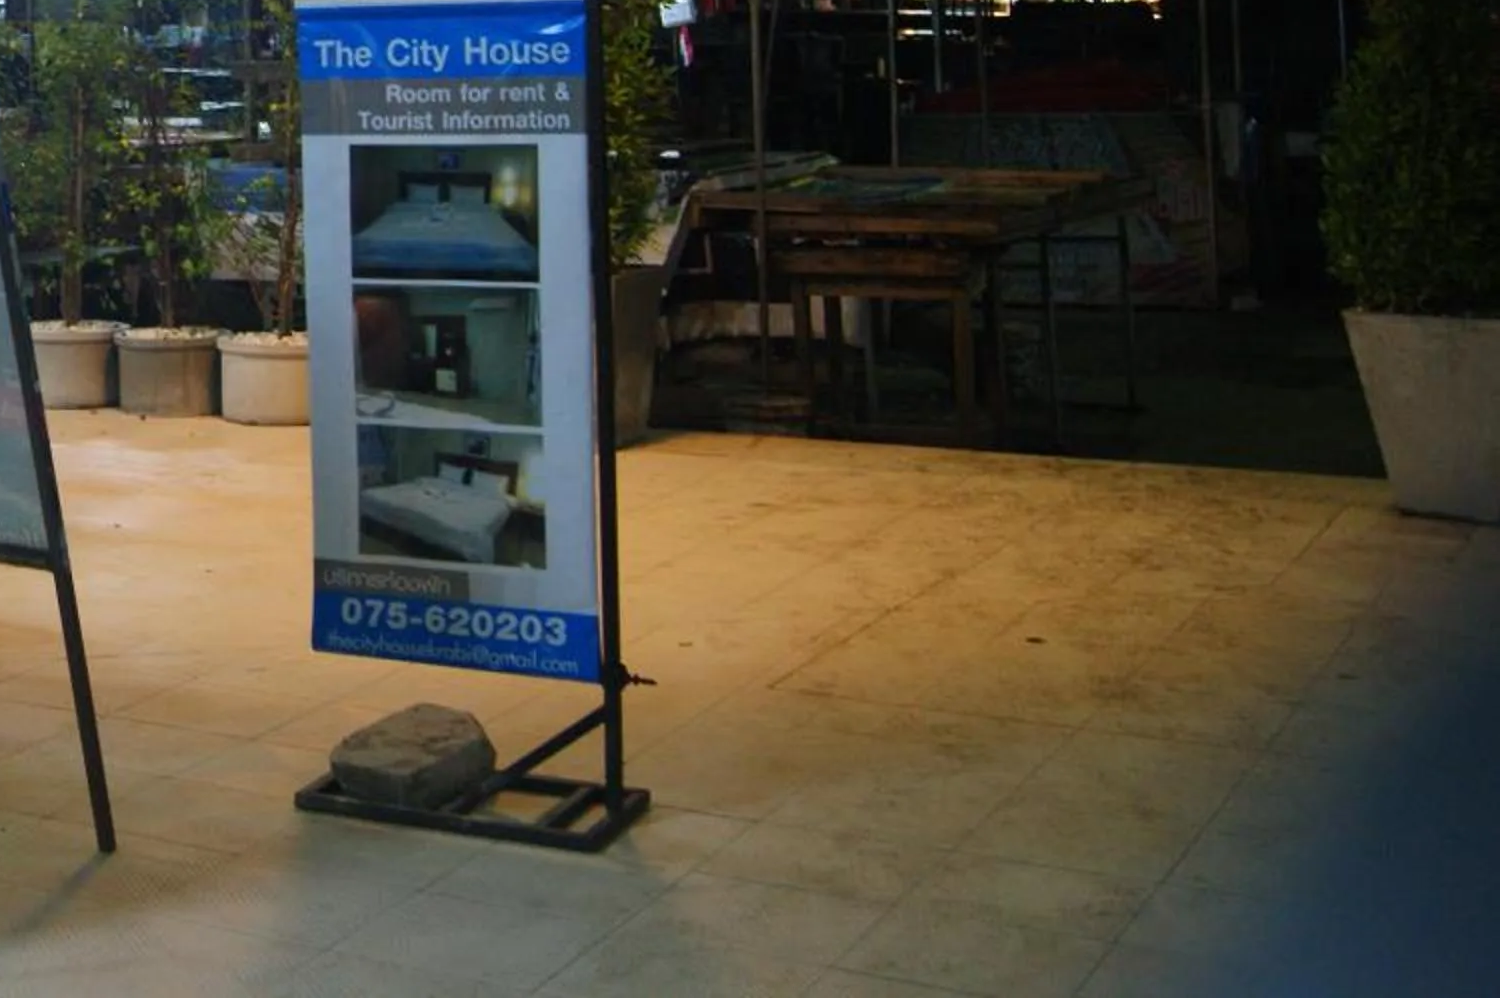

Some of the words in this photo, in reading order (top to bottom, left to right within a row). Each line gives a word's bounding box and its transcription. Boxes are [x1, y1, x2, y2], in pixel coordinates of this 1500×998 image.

[314, 39, 371, 68] The
[386, 37, 449, 73] City
[464, 36, 570, 65] House
[385, 84, 451, 103] Room
[460, 83, 491, 103] for
[500, 83, 546, 102] rent
[555, 82, 570, 102] &
[358, 111, 434, 131] Tourist
[442, 110, 570, 130] Information
[341, 598, 568, 645] 075-620203
